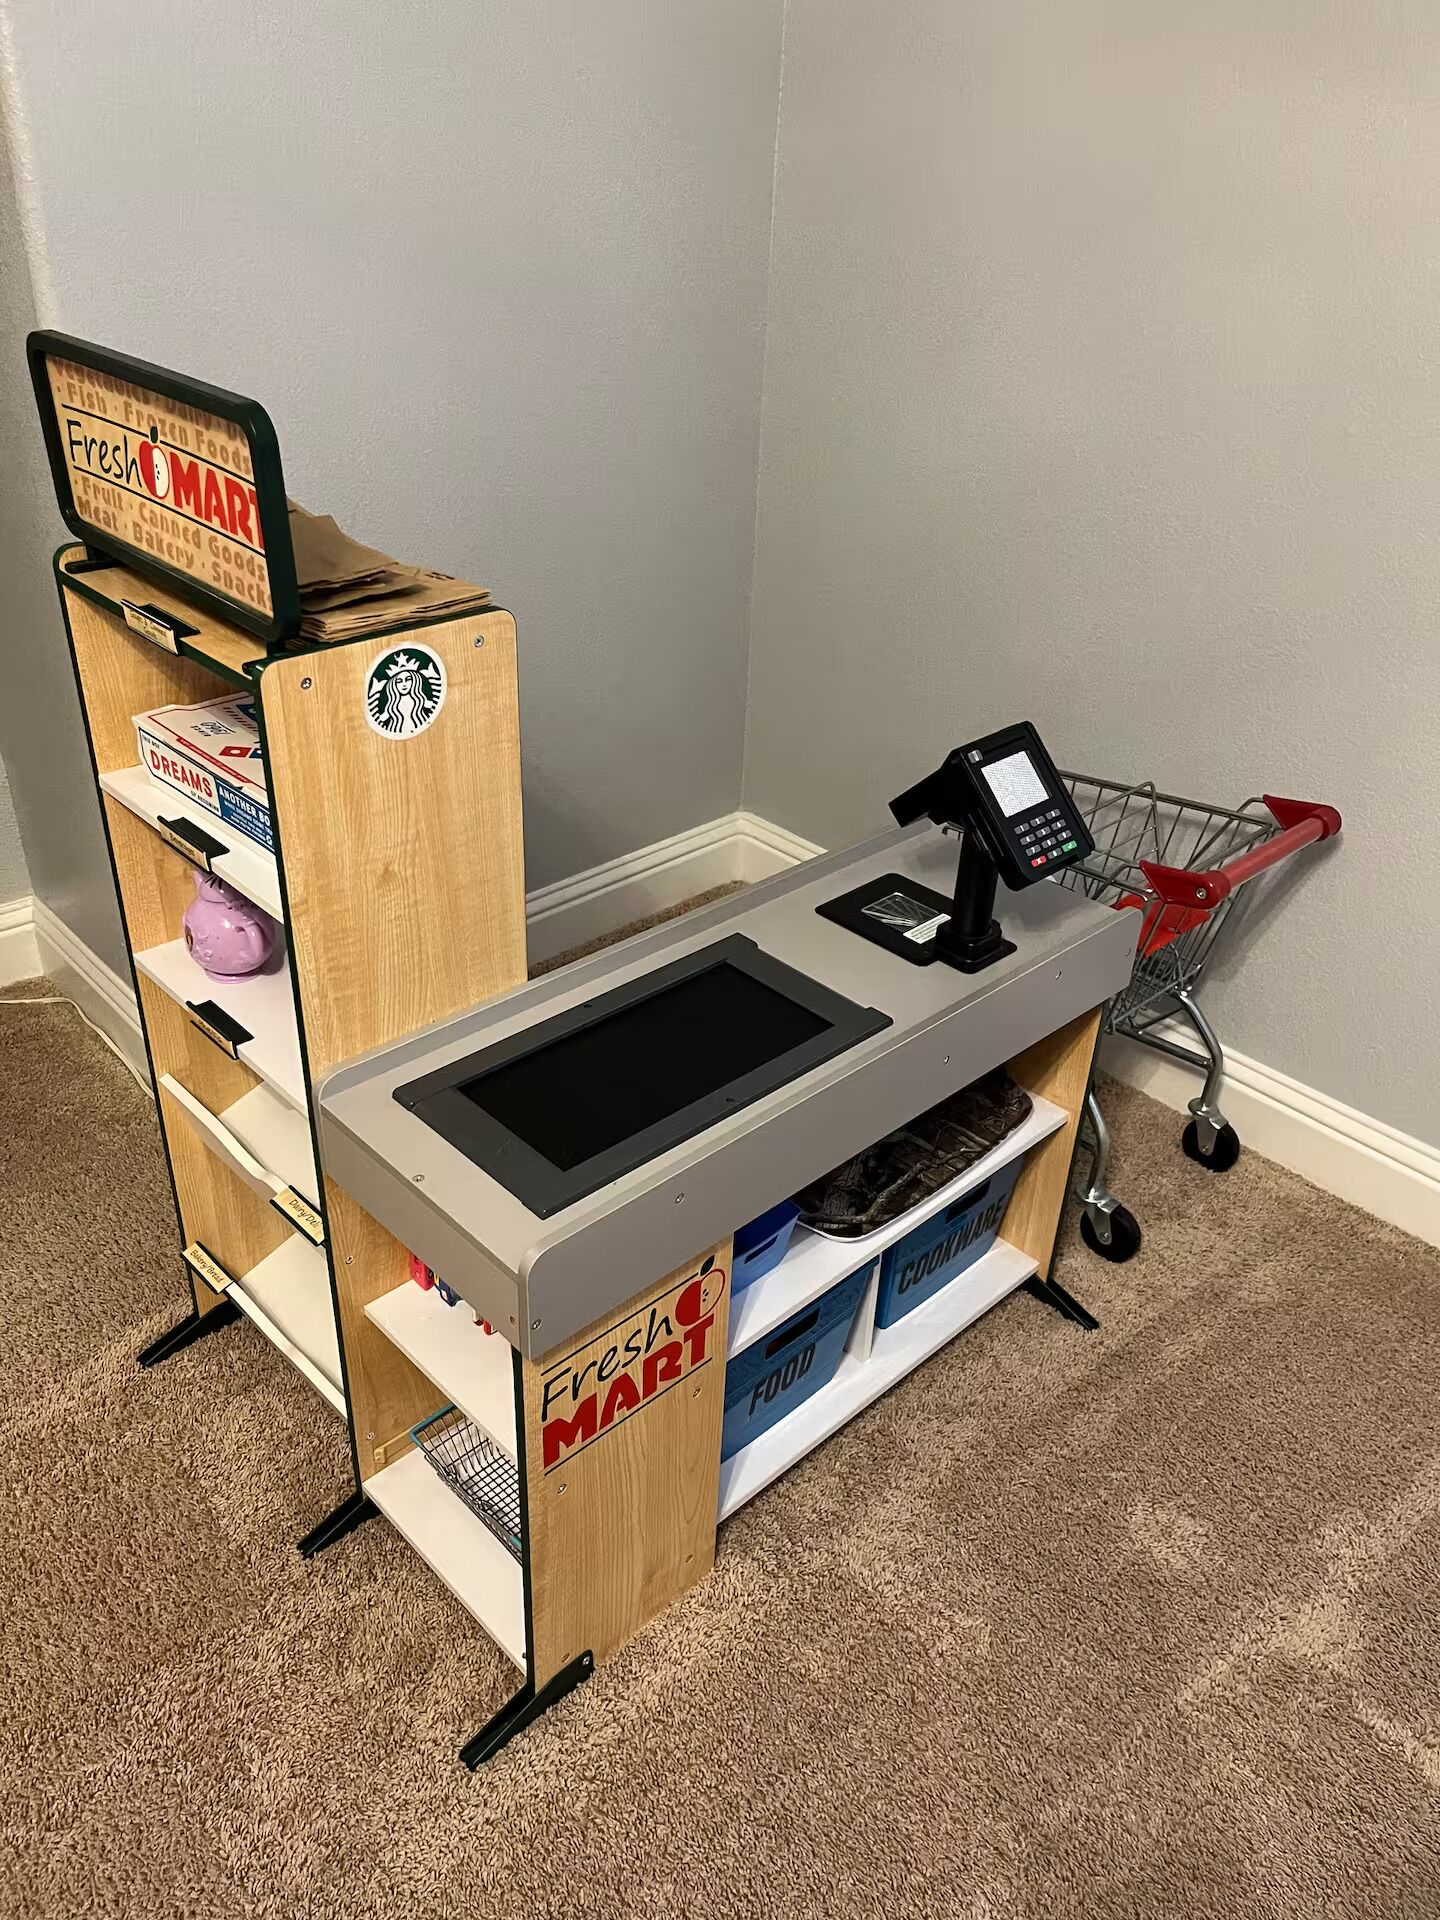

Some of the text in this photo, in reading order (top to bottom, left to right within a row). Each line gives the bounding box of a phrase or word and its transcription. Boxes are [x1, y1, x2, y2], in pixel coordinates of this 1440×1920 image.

[66, 418, 142, 488] Fresh
[67, 381, 252, 476] Fish Frozen Foods
[77, 495, 119, 532] Meat
[132, 519, 195, 570] Bakery
[81, 475, 265, 583] Fruit Canned Goods
[150, 749, 213, 798] DREAMS
[218, 785, 258, 819] ANOTHER
[258, 810, 271, 828] BO
[897, 1194, 1008, 1296] COOKWARE
[540, 1308, 674, 1422] Fresh
[542, 1312, 715, 1469] MART
[748, 1341, 818, 1417] FOOD
